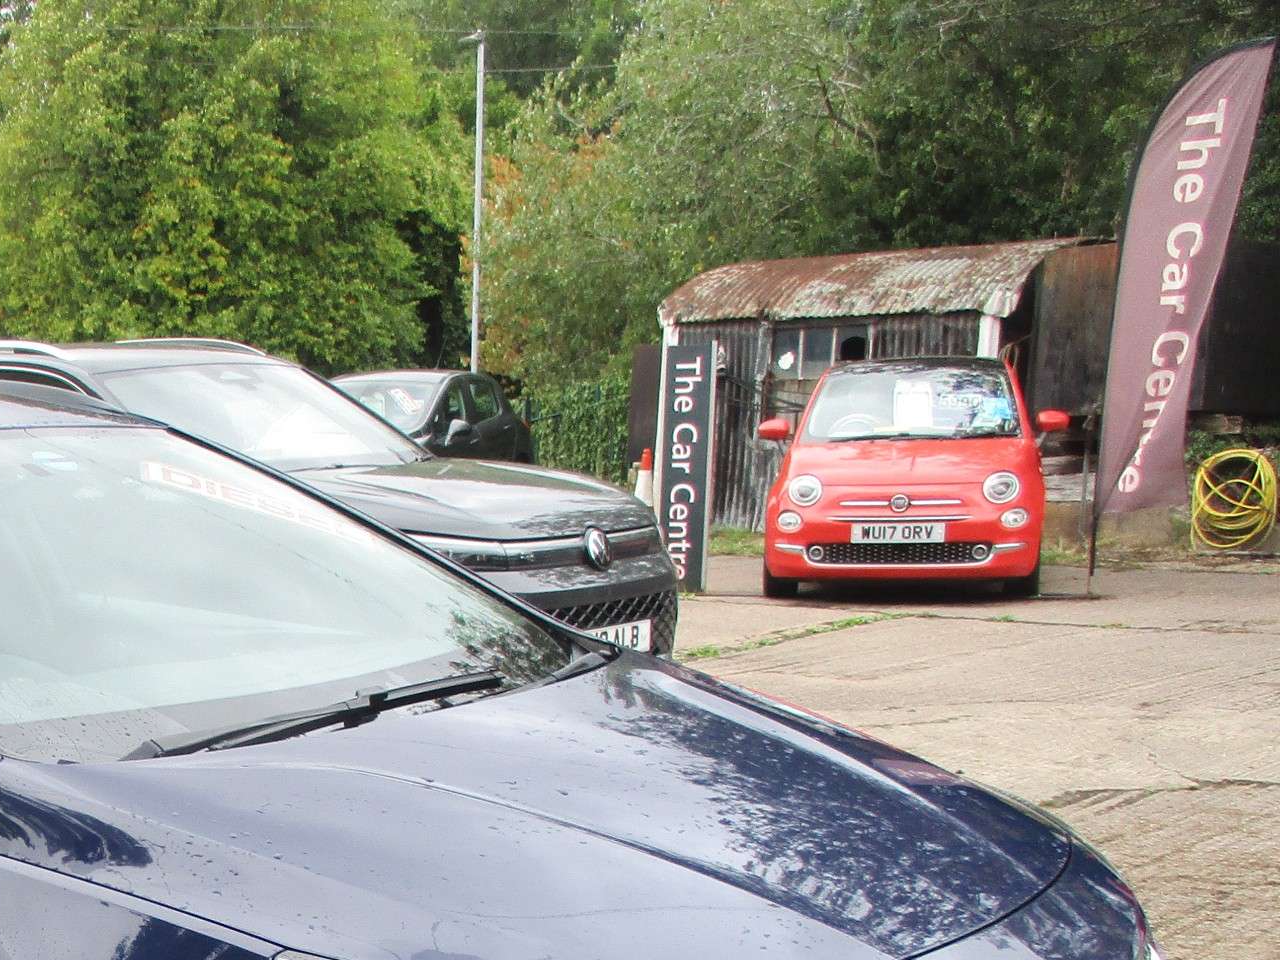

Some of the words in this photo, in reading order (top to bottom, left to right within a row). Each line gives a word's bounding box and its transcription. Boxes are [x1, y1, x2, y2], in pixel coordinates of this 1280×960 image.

[1172, 98, 1227, 204] The
[1159, 221, 1204, 315] Car
[673, 355, 703, 414] The
[671, 422, 699, 475] Car
[161, 464, 368, 546] DIESEL
[861, 525, 897, 540] WU17
